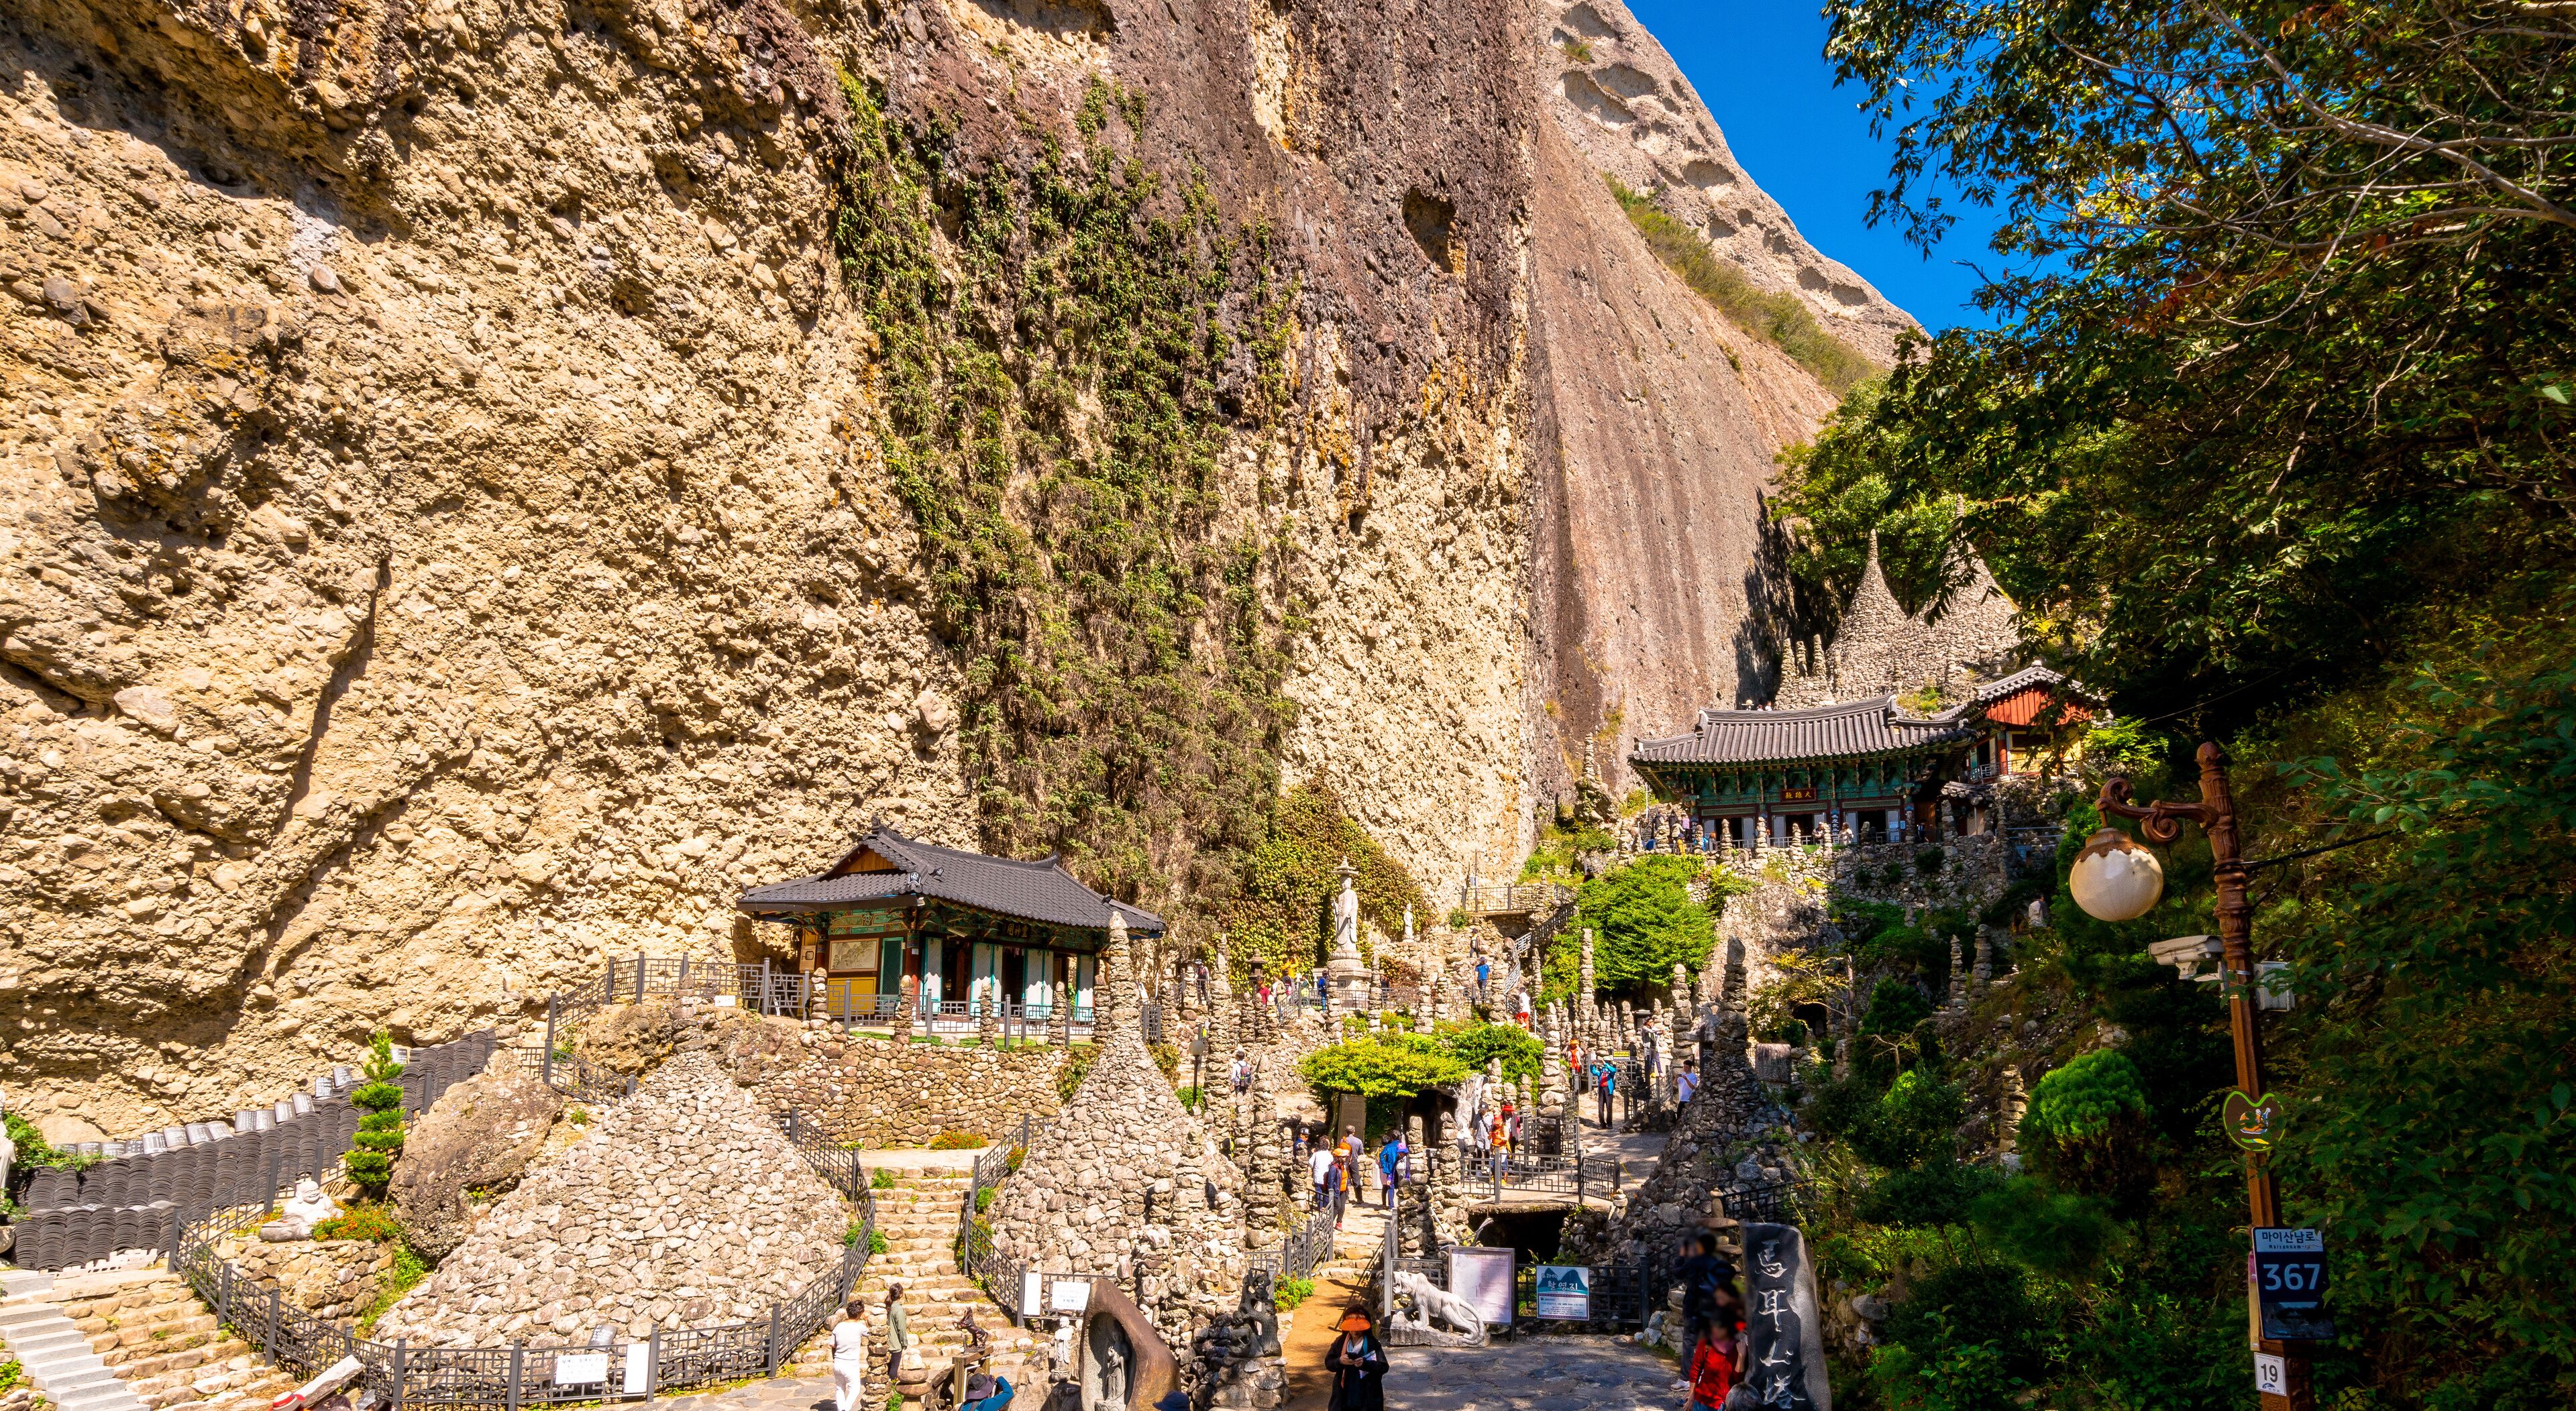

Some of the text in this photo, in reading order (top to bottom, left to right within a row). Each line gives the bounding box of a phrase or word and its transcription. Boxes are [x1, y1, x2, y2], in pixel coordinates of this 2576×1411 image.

[2262, 1231, 2315, 1243] 마이산남로
[2263, 1263, 2320, 1290] 367
[2261, 1363, 2278, 1383] 19
